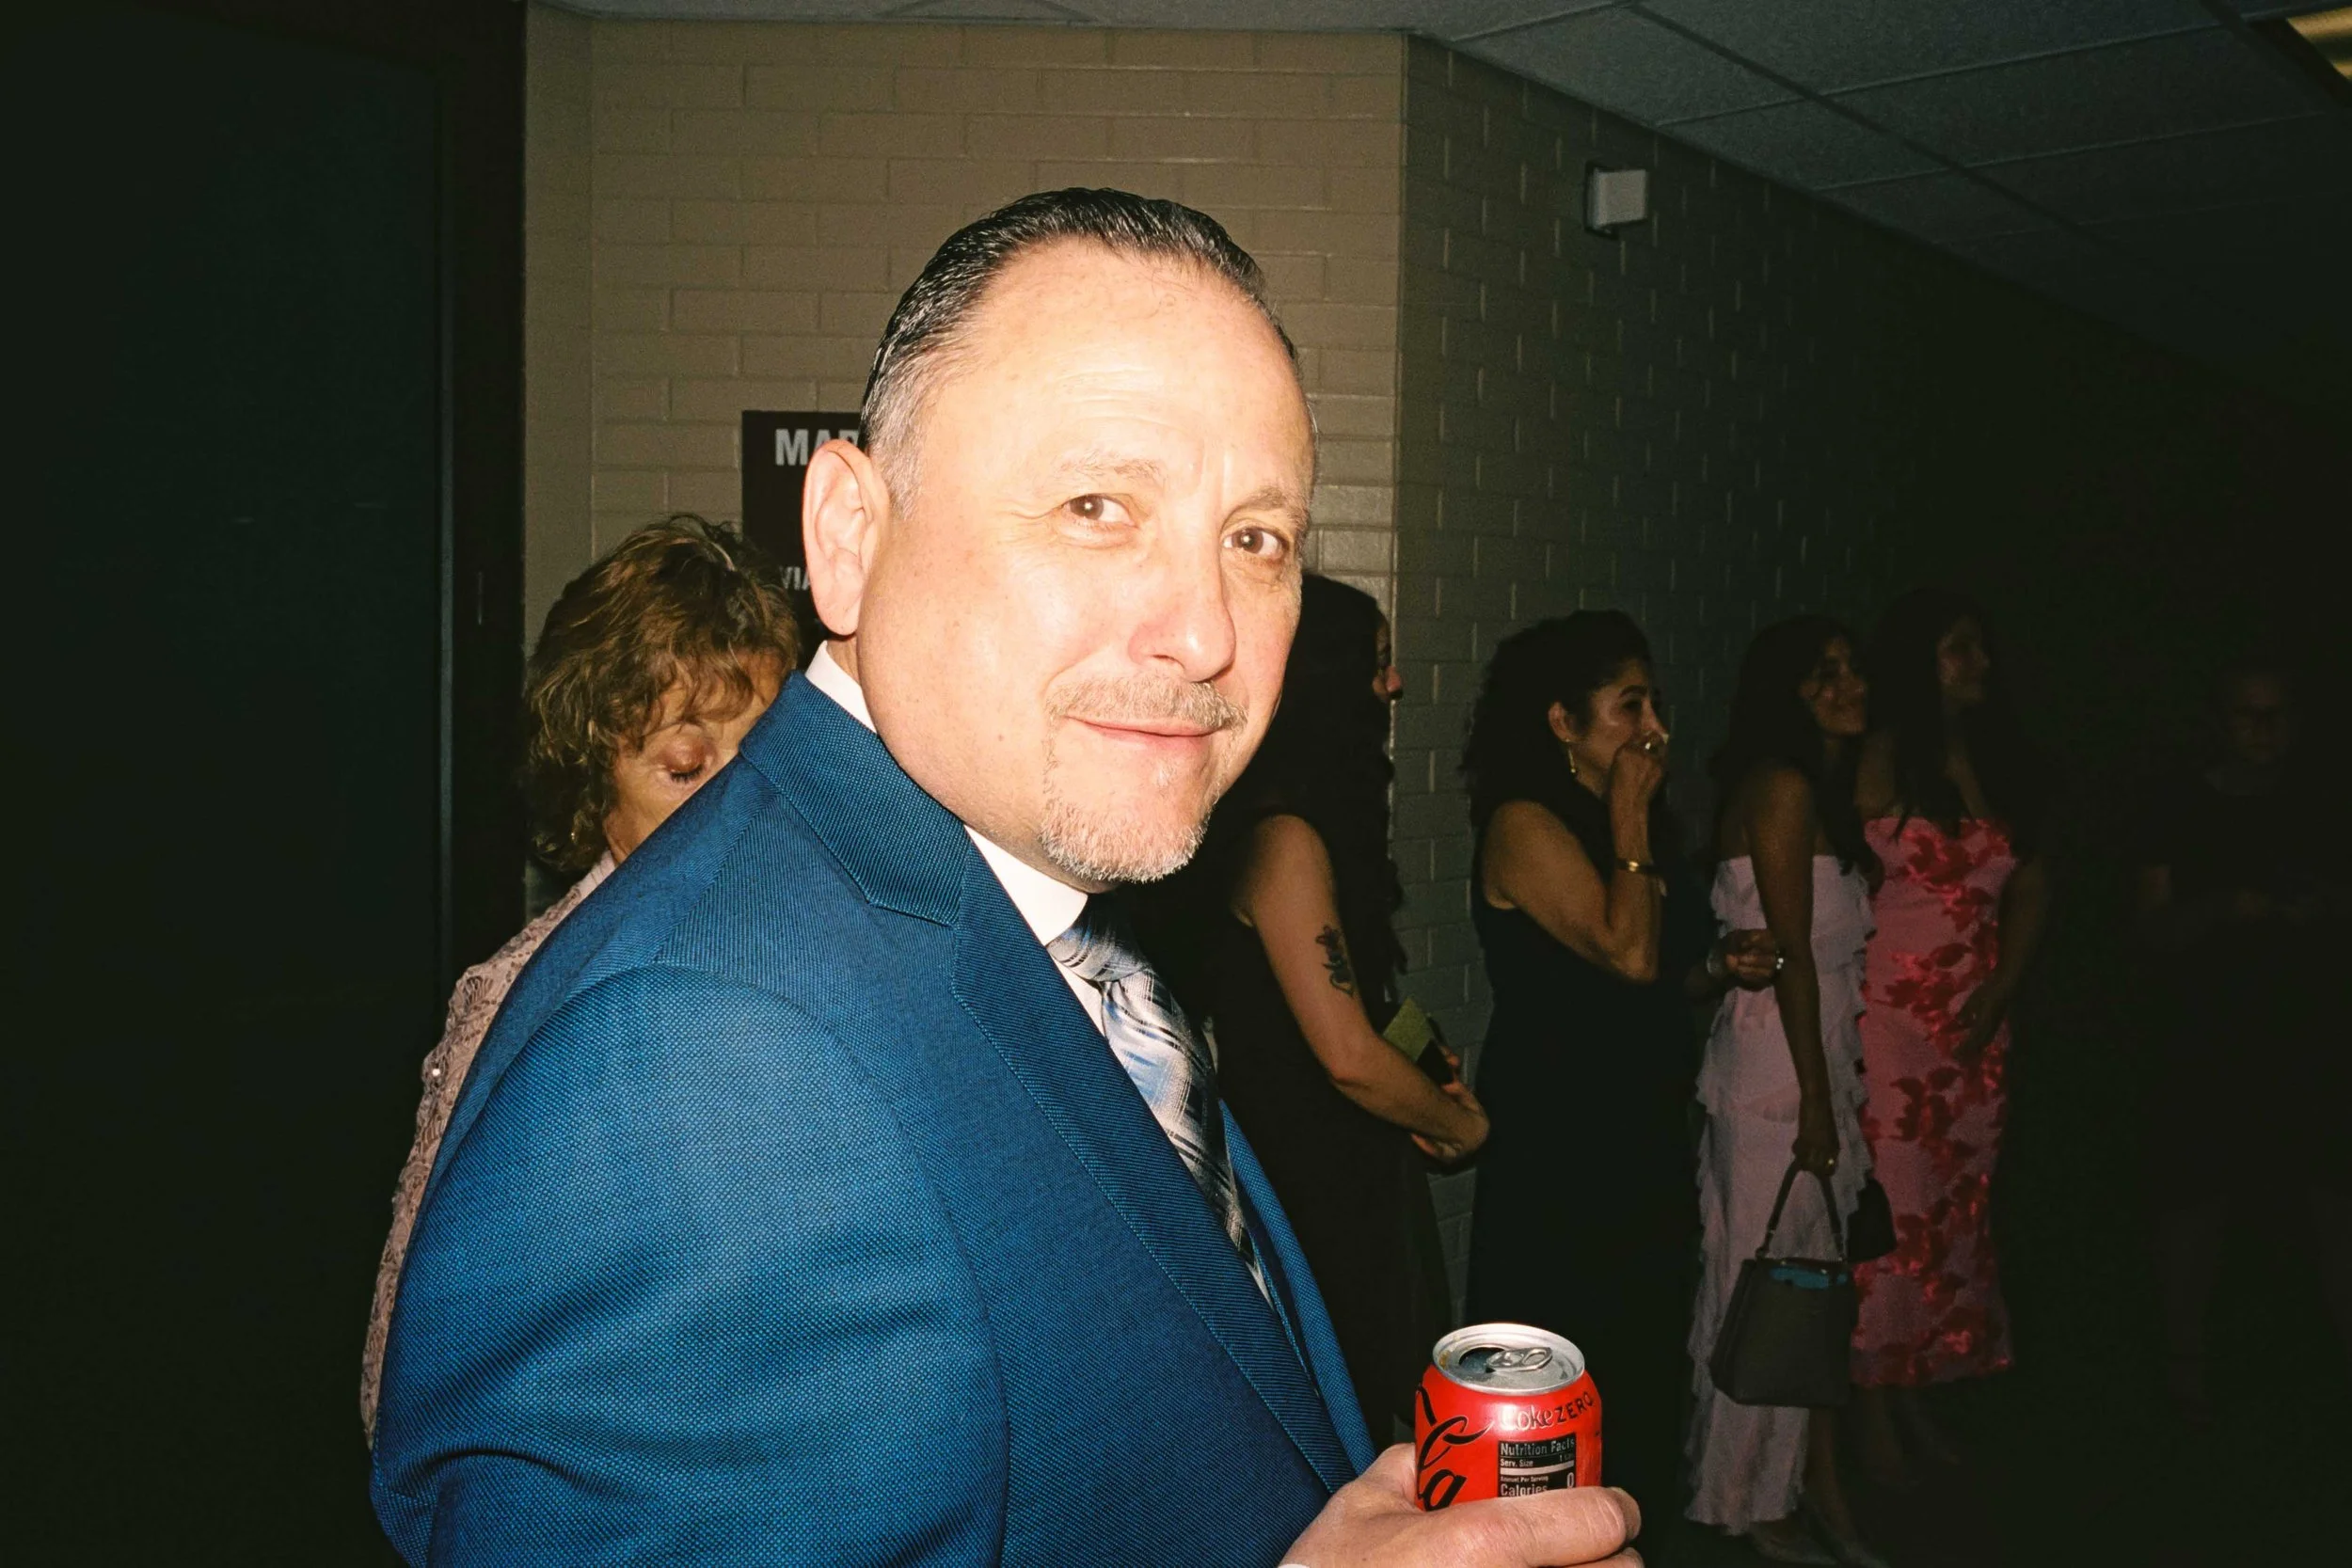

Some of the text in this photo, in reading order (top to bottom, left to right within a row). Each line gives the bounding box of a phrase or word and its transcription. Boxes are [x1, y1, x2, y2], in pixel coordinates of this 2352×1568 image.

[1555, 1391, 1594, 1423] ZERO
[1501, 1437, 1575, 1456] Nutrition Facts
[1500, 1458, 1518, 1467] Serv.
[1500, 1472, 1575, 1497] Calories 0
